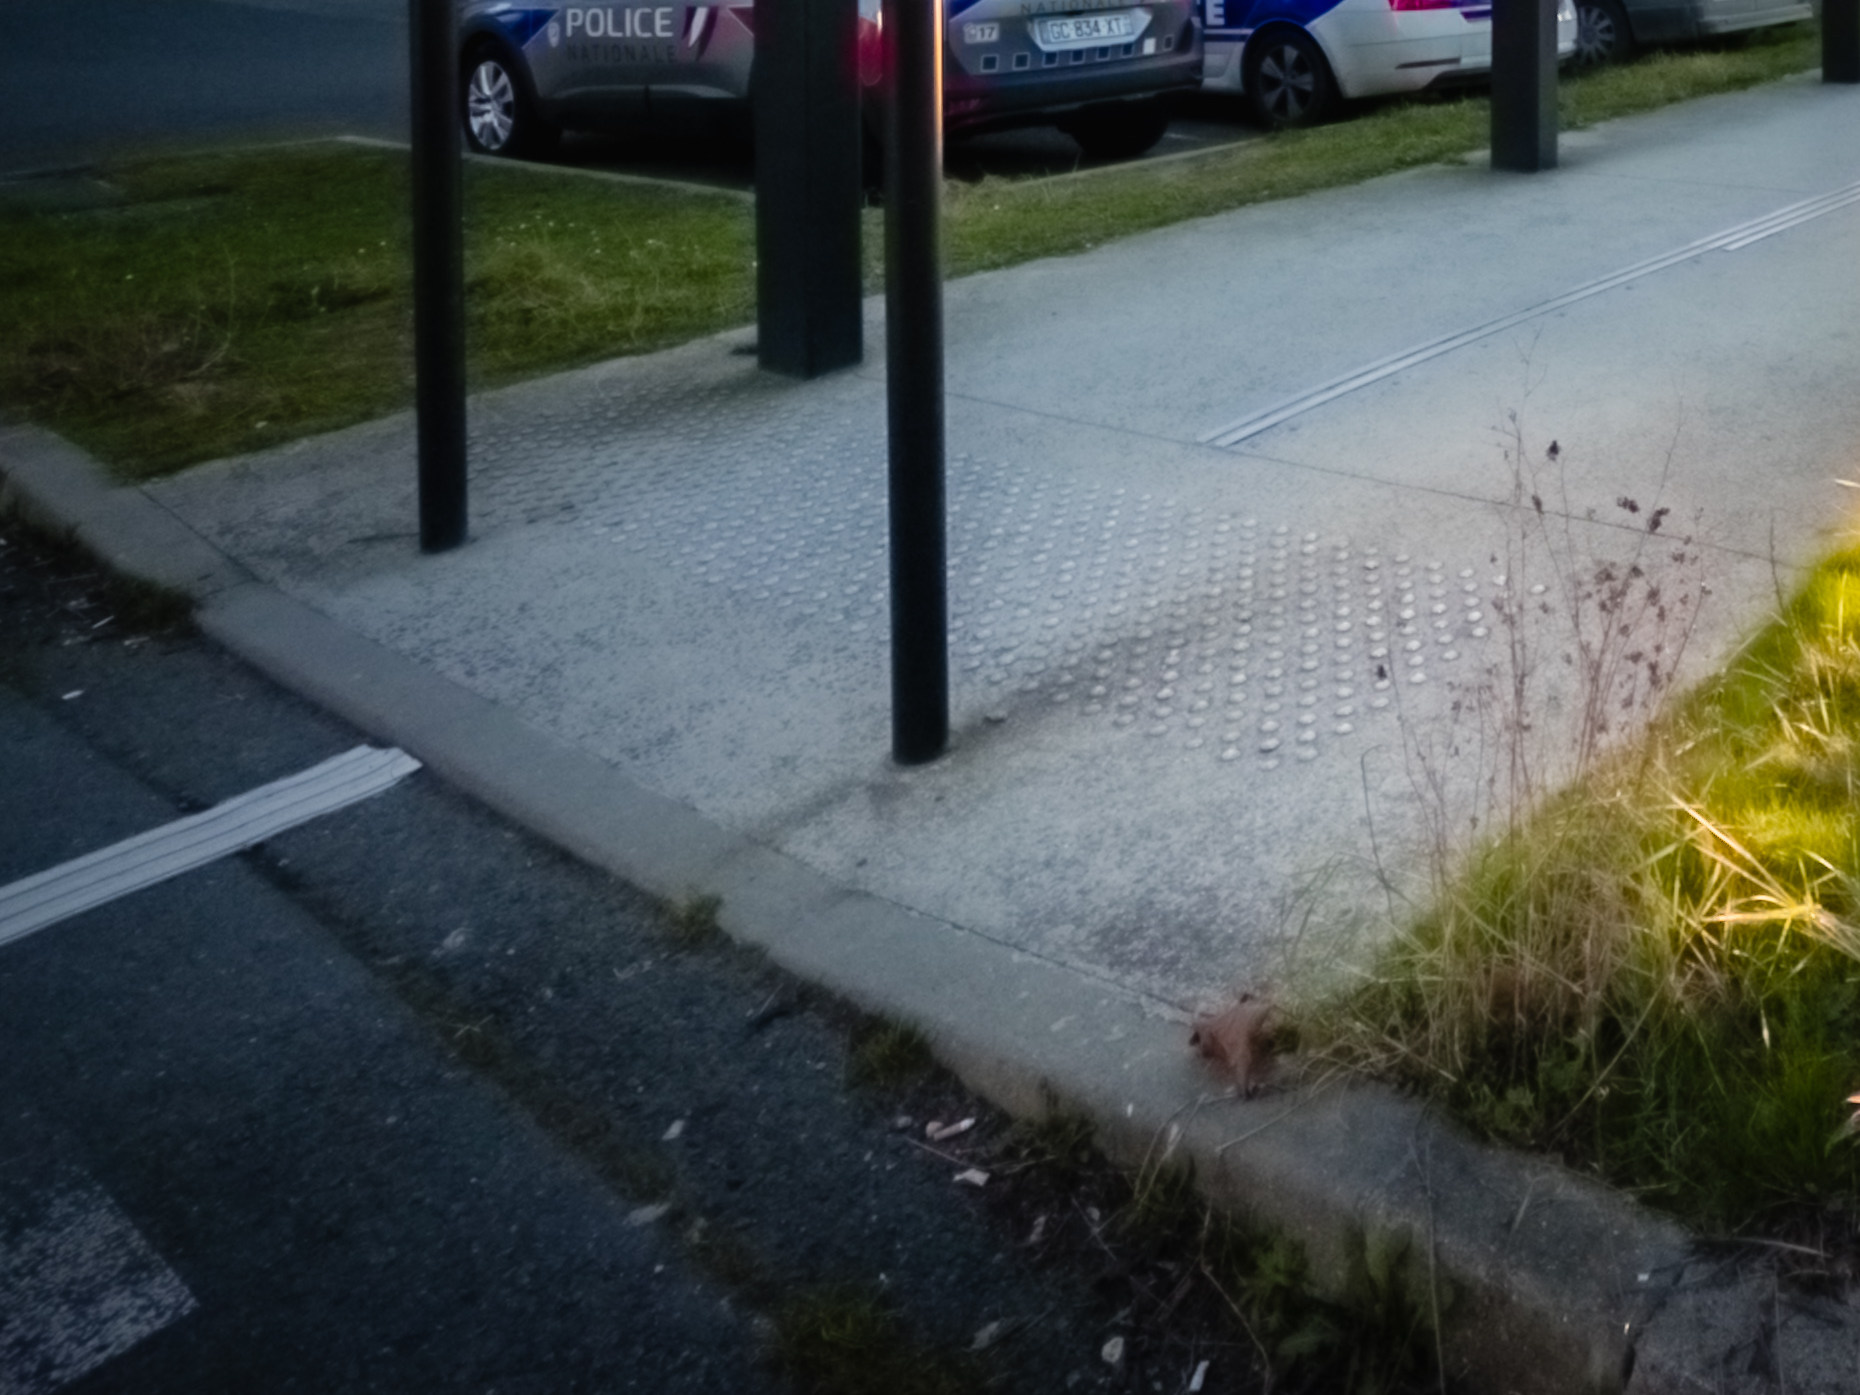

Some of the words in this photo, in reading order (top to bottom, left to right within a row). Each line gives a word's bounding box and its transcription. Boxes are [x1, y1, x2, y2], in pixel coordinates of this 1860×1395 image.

[566, 7, 674, 38] POLICE
[979, 26, 996, 39] 17
[566, 44, 677, 63] NATIONALE
